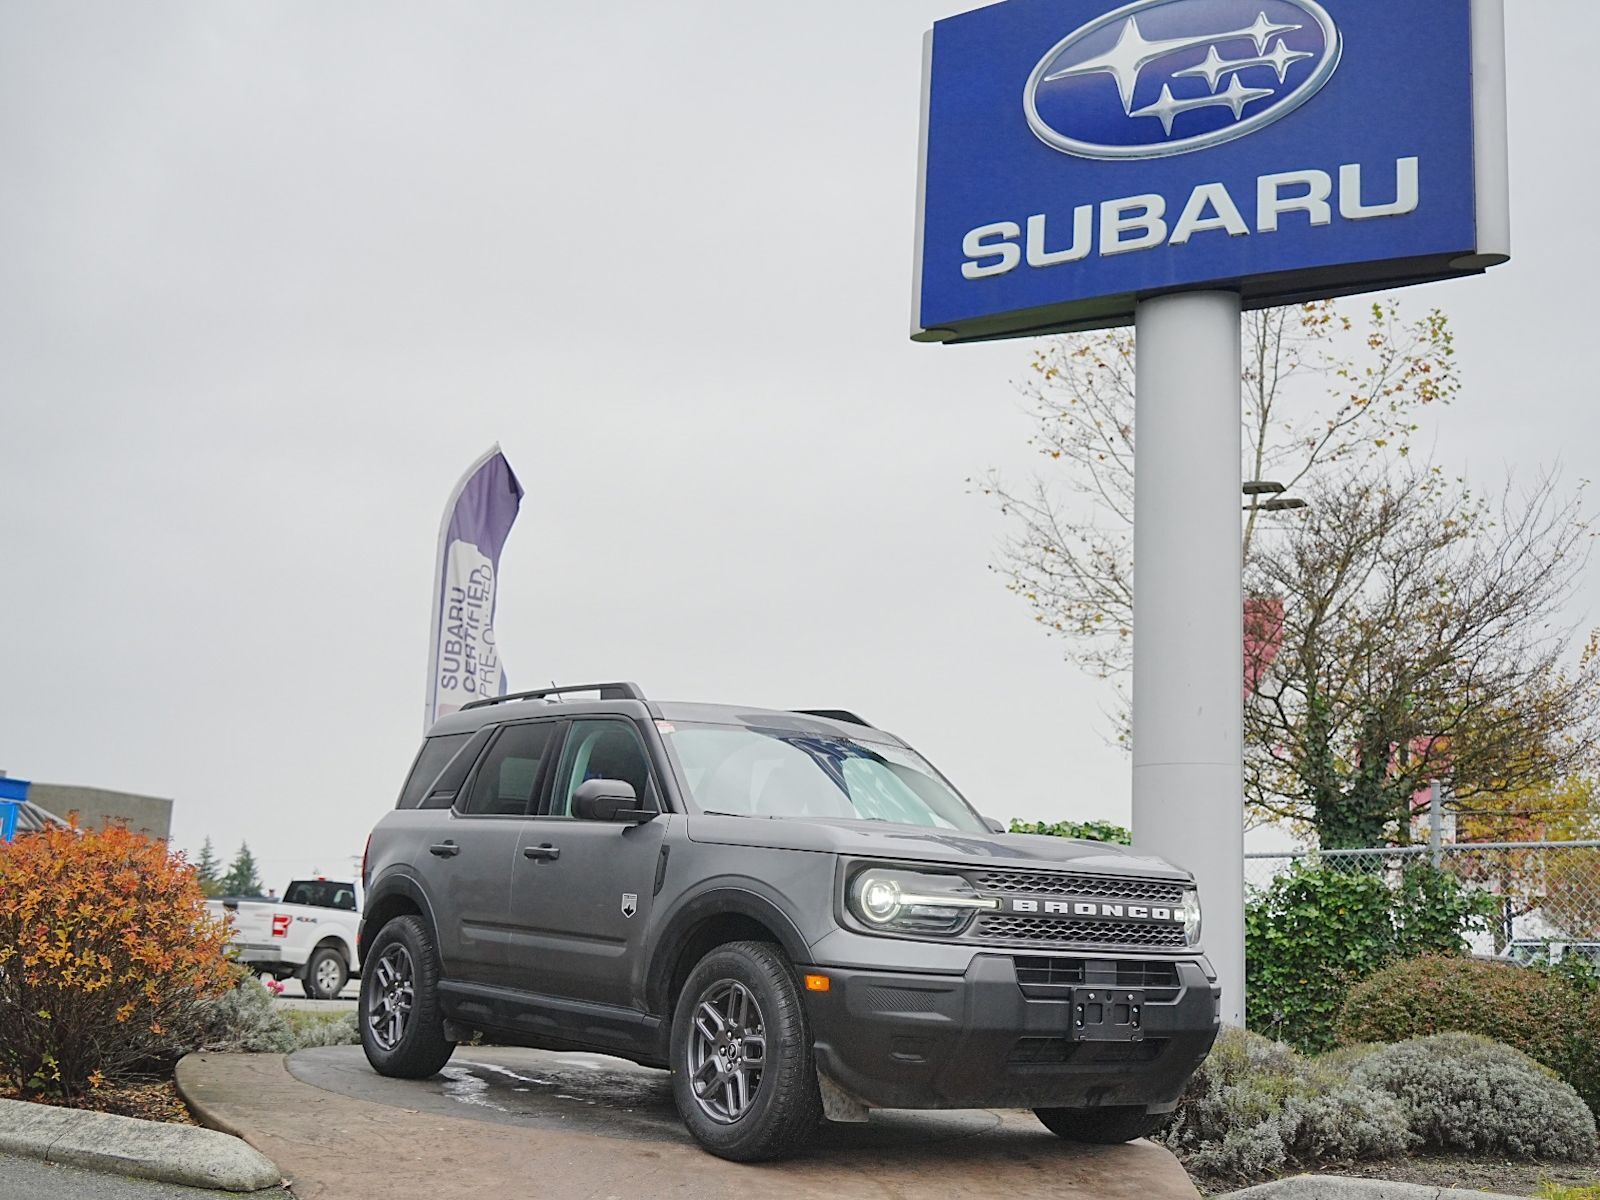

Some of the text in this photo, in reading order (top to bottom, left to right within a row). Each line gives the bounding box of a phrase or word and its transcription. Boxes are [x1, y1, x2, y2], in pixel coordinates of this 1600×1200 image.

[961, 156, 1419, 281] SUBARU
[441, 586, 466, 690] SUBARU
[463, 568, 484, 693] CERTIFIED
[479, 564, 497, 699] PRE-OED
[1012, 899, 1171, 920] BRONCO
